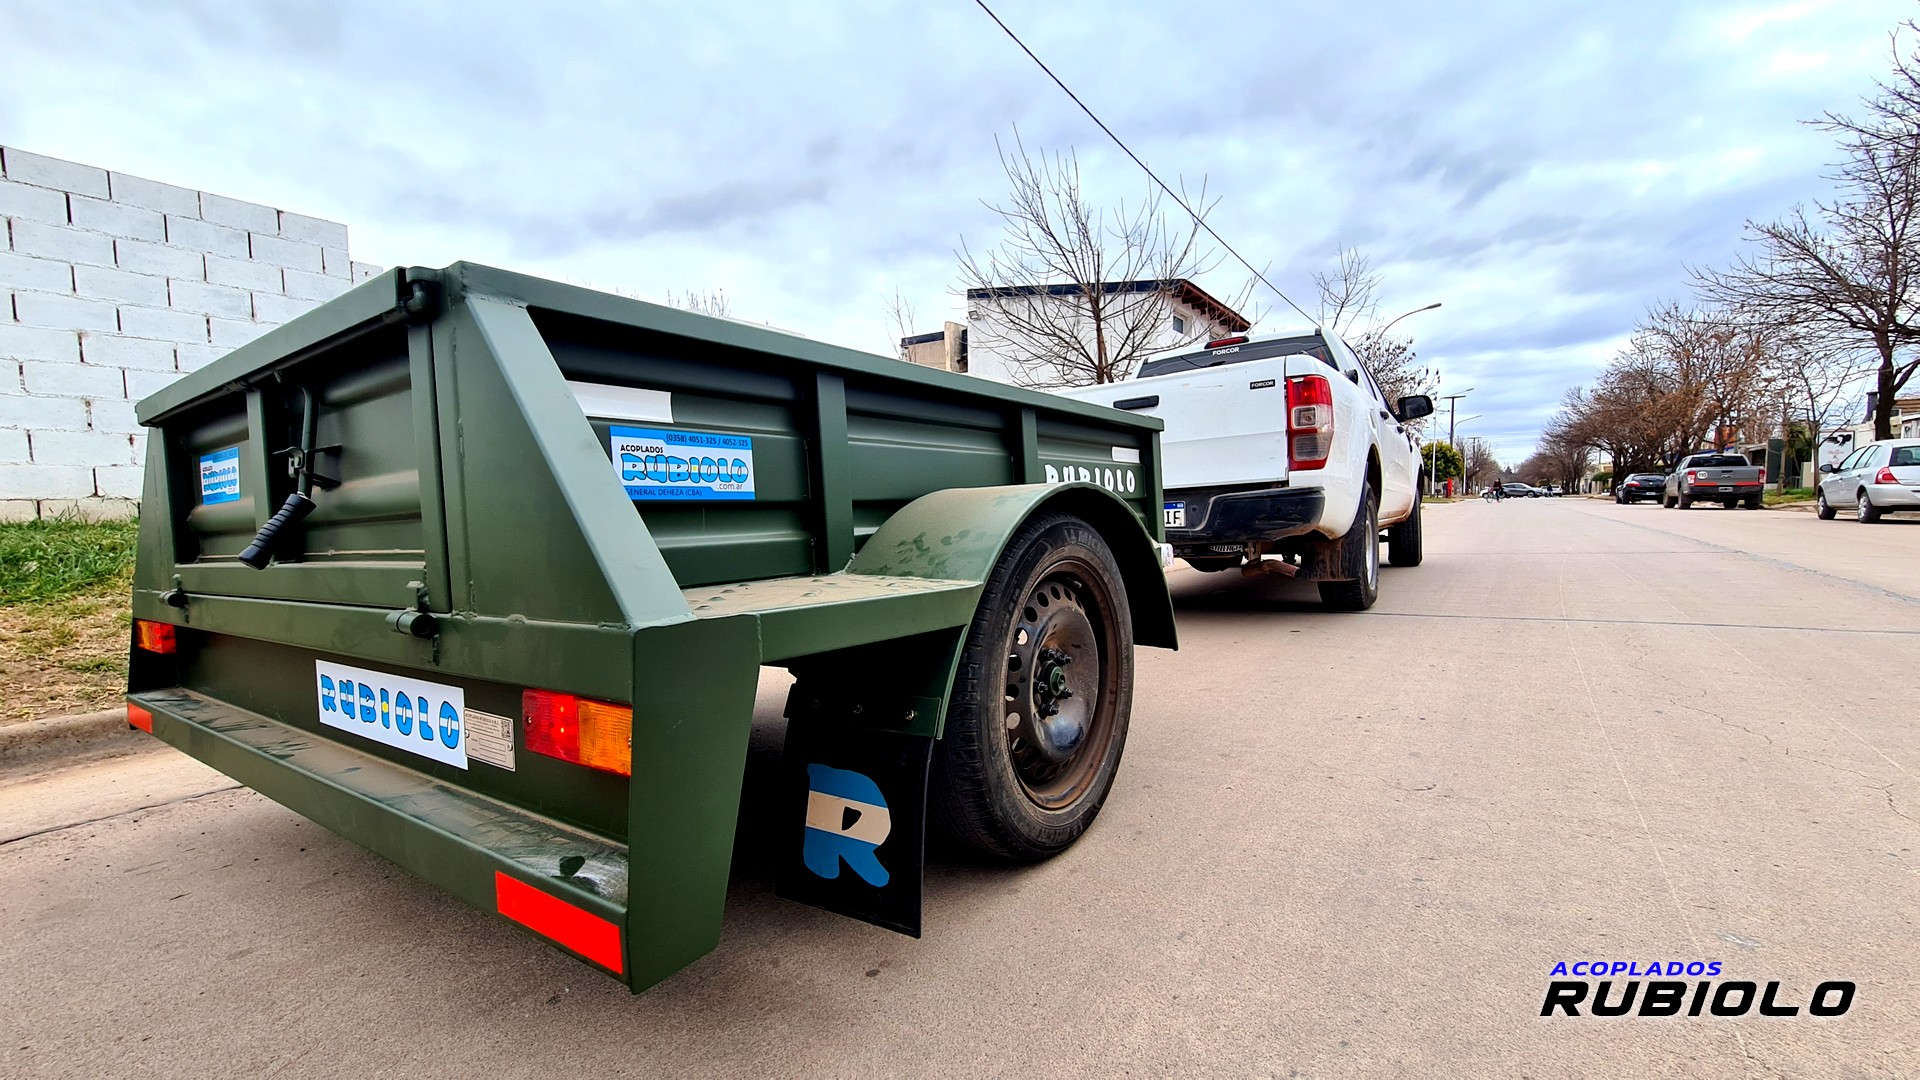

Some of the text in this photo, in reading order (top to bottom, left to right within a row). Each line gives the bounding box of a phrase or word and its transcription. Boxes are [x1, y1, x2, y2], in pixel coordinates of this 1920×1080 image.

[1212, 346, 1240, 356] FORCOR
[1251, 380, 1274, 388] FORCOR
[666, 432, 687, 443] (0358)
[688, 435, 717, 445] 4051-325
[722, 438, 748, 447] 4052-325
[620, 444, 664, 454] ACOPLADOS
[620, 452, 749, 483] RUBIOLO
[717, 482, 743, 490] .com.ar
[658, 488, 684, 496] DEHEZA
[685, 488, 703, 497] (CBA)
[320, 673, 460, 750] RUBIOLO
[802, 763, 891, 887] R
